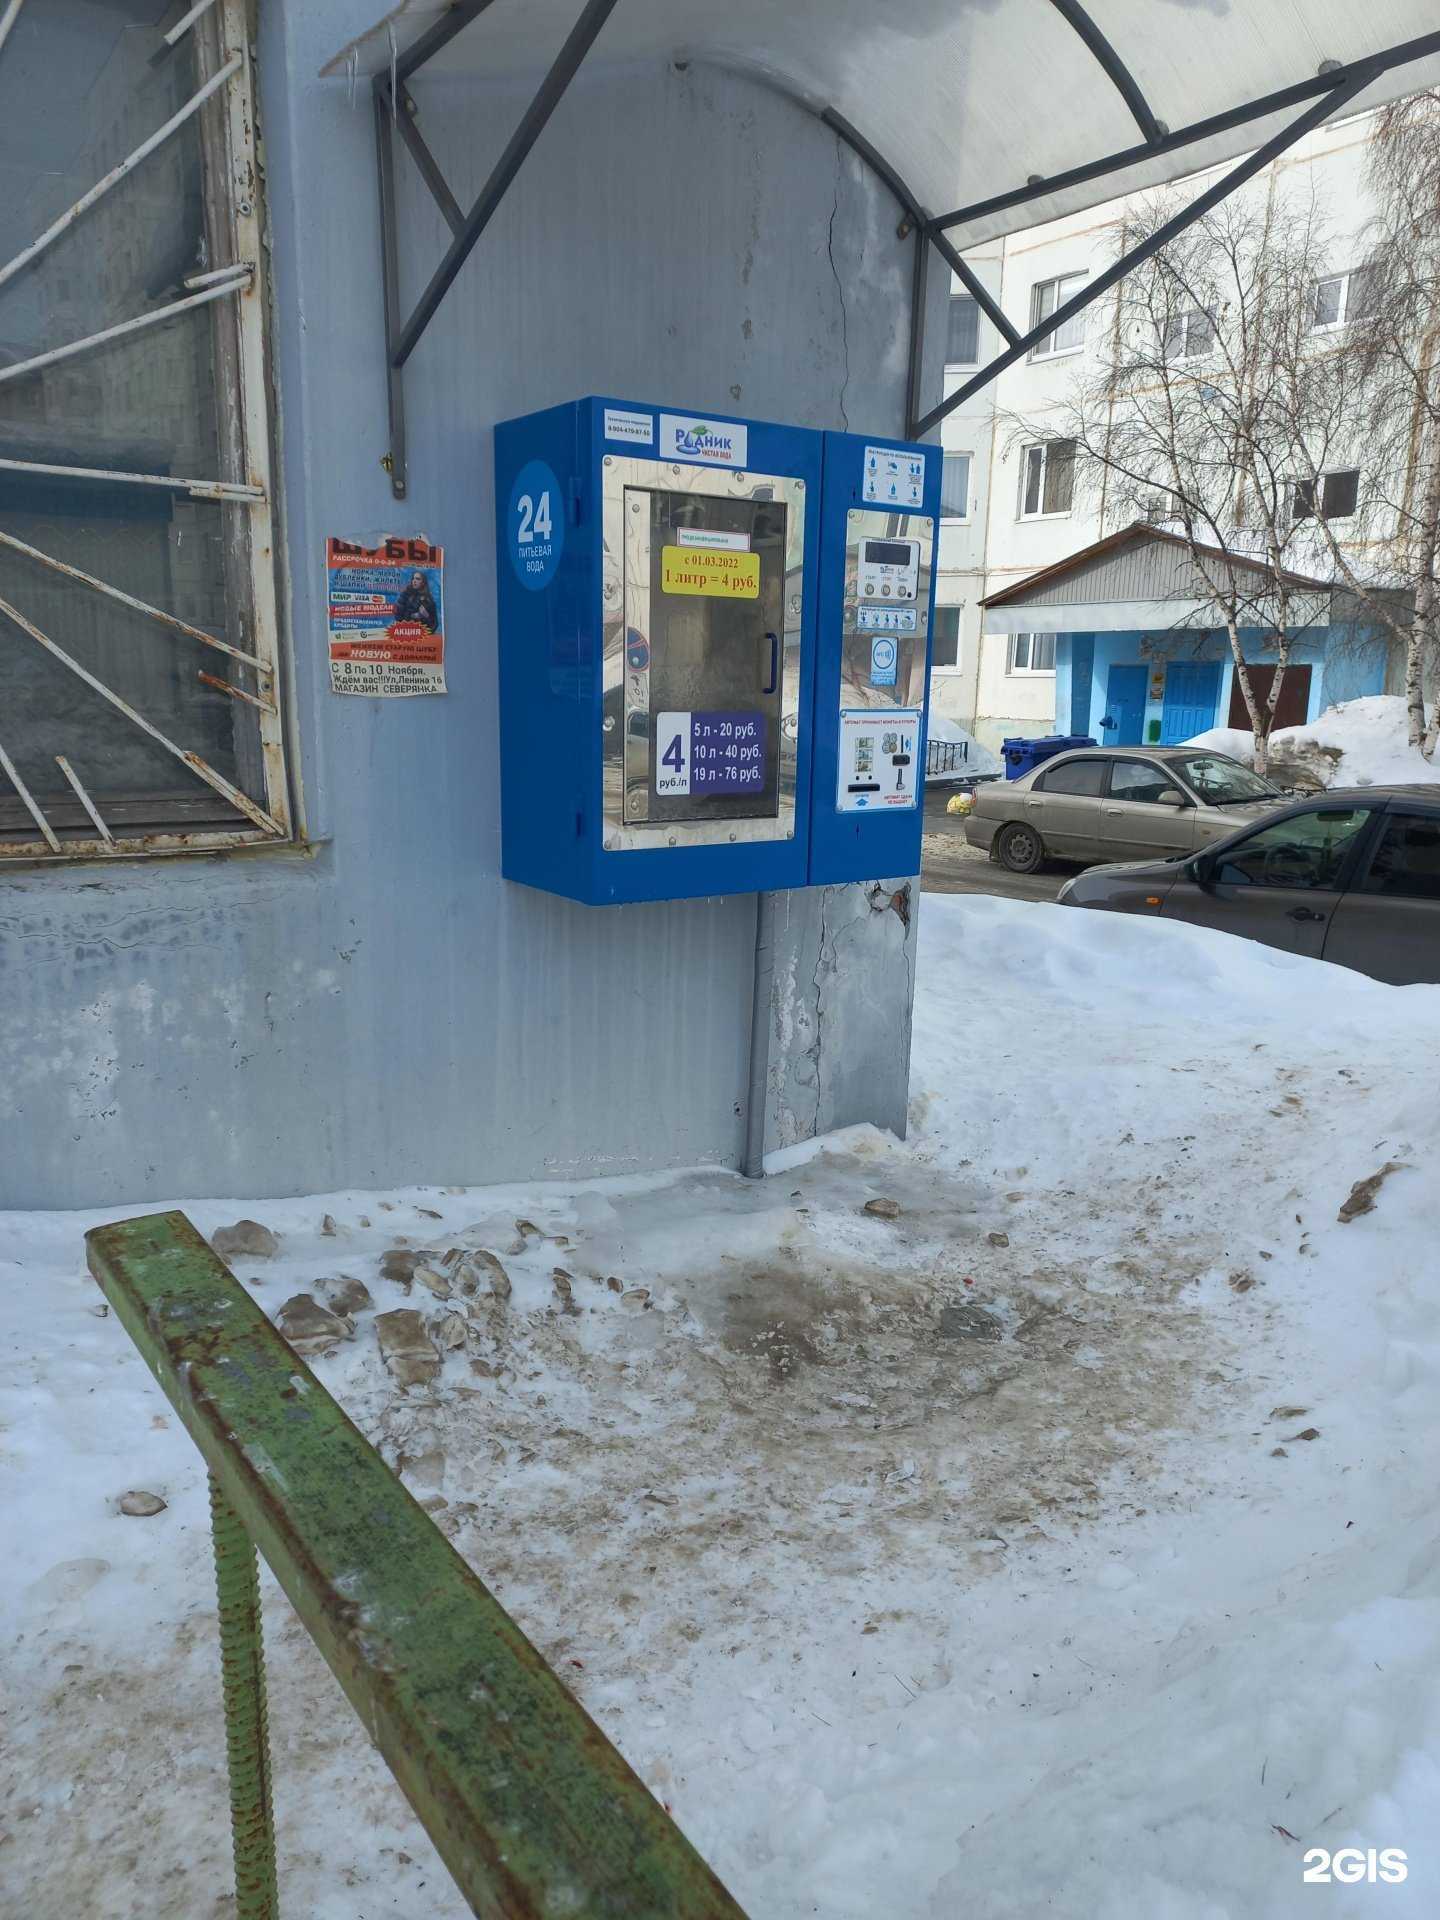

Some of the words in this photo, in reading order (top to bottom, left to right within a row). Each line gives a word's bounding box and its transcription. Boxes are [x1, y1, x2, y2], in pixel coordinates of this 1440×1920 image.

[517, 491, 553, 543] 24
[518, 544, 552, 558] ПИТЬЕВАЯ
[332, 554, 373, 565] РАССРОЧКА
[526, 560, 544, 573] ВОДА
[684, 557, 690, 565] с
[692, 554, 739, 569] 01.03.2022
[666, 569, 671, 582] 1
[675, 573, 707, 588] литр
[721, 573, 729, 586] 4
[732, 575, 757, 591] руб.
[332, 593, 352, 601] МИР
[394, 627, 421, 636] АКЦИЯ
[350, 649, 391, 659] НОВУЮ
[331, 662, 339, 673] С
[344, 662, 352, 675] 8
[354, 665, 367, 674] По
[369, 664, 383, 675] 10
[388, 664, 426, 676] Ноября.
[333, 674, 361, 685] Ждём
[334, 684, 379, 693] МАГАЗИН
[383, 685, 438, 693] СЕВЕРЯНКА
[694, 723, 701, 737] 5
[703, 727, 711, 737] л
[719, 722, 732, 737] 20
[735, 722, 757, 740] руб.
[662, 734, 686, 773] 4
[694, 745, 706, 759] 10
[708, 748, 716, 759] л
[725, 744, 738, 758] 40
[740, 744, 762, 761] руб.
[694, 767, 706, 781] 19
[708, 770, 716, 781] л
[724, 766, 737, 780] 76
[740, 766, 761, 783] руб.
[659, 777, 687, 789] руб./л
